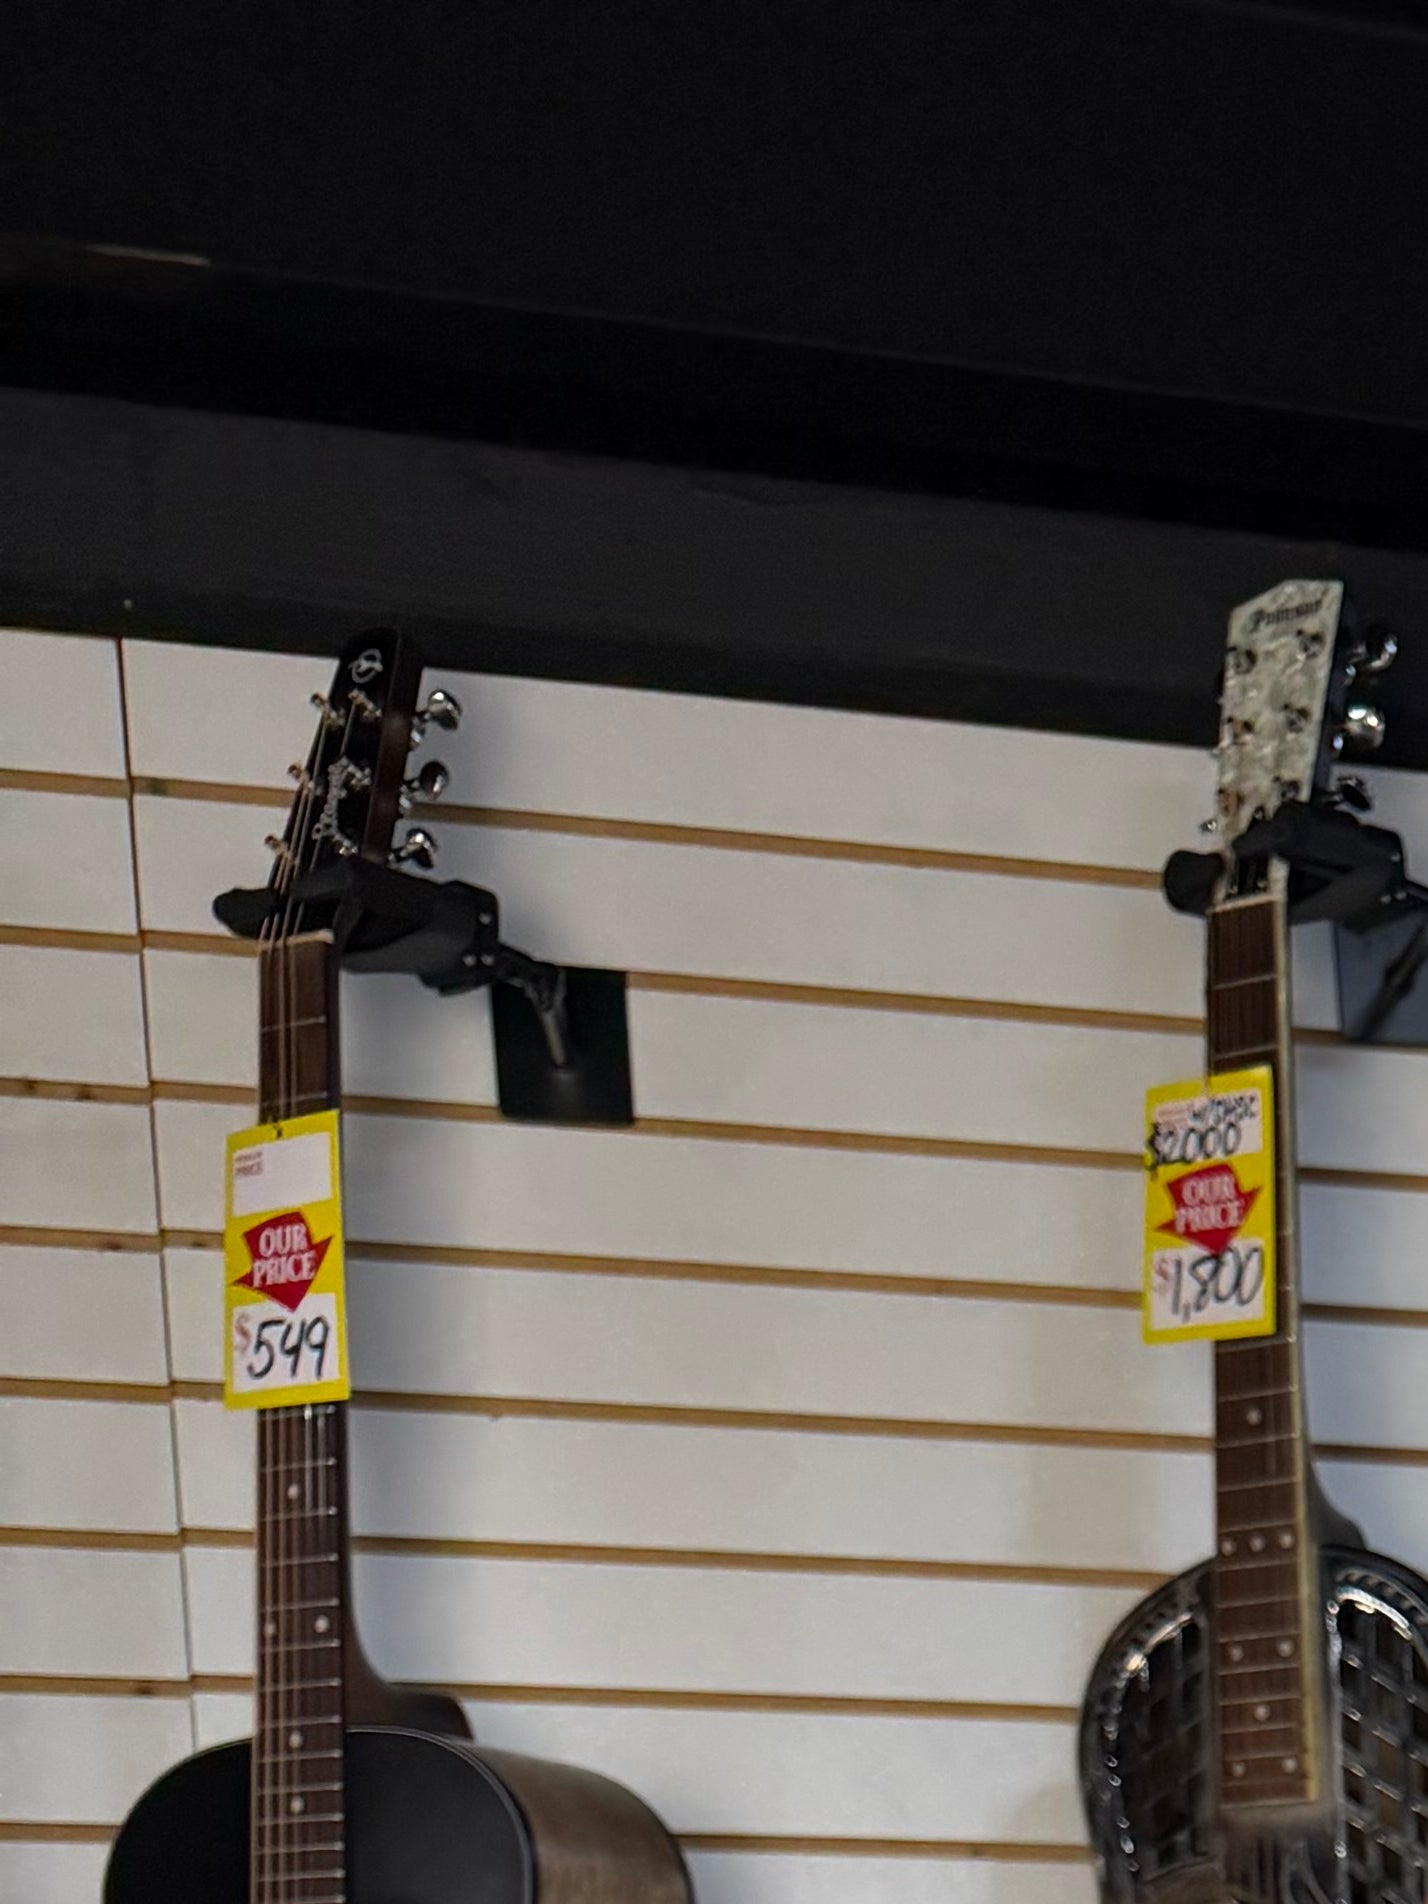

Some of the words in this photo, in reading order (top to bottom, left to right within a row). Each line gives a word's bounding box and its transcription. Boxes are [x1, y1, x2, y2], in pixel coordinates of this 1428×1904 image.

[1181, 1176, 1237, 1206] OUR
[1174, 1200, 1245, 1234] PRICE
[259, 1223, 308, 1255] OUR
[252, 1253, 316, 1288] PRICE
